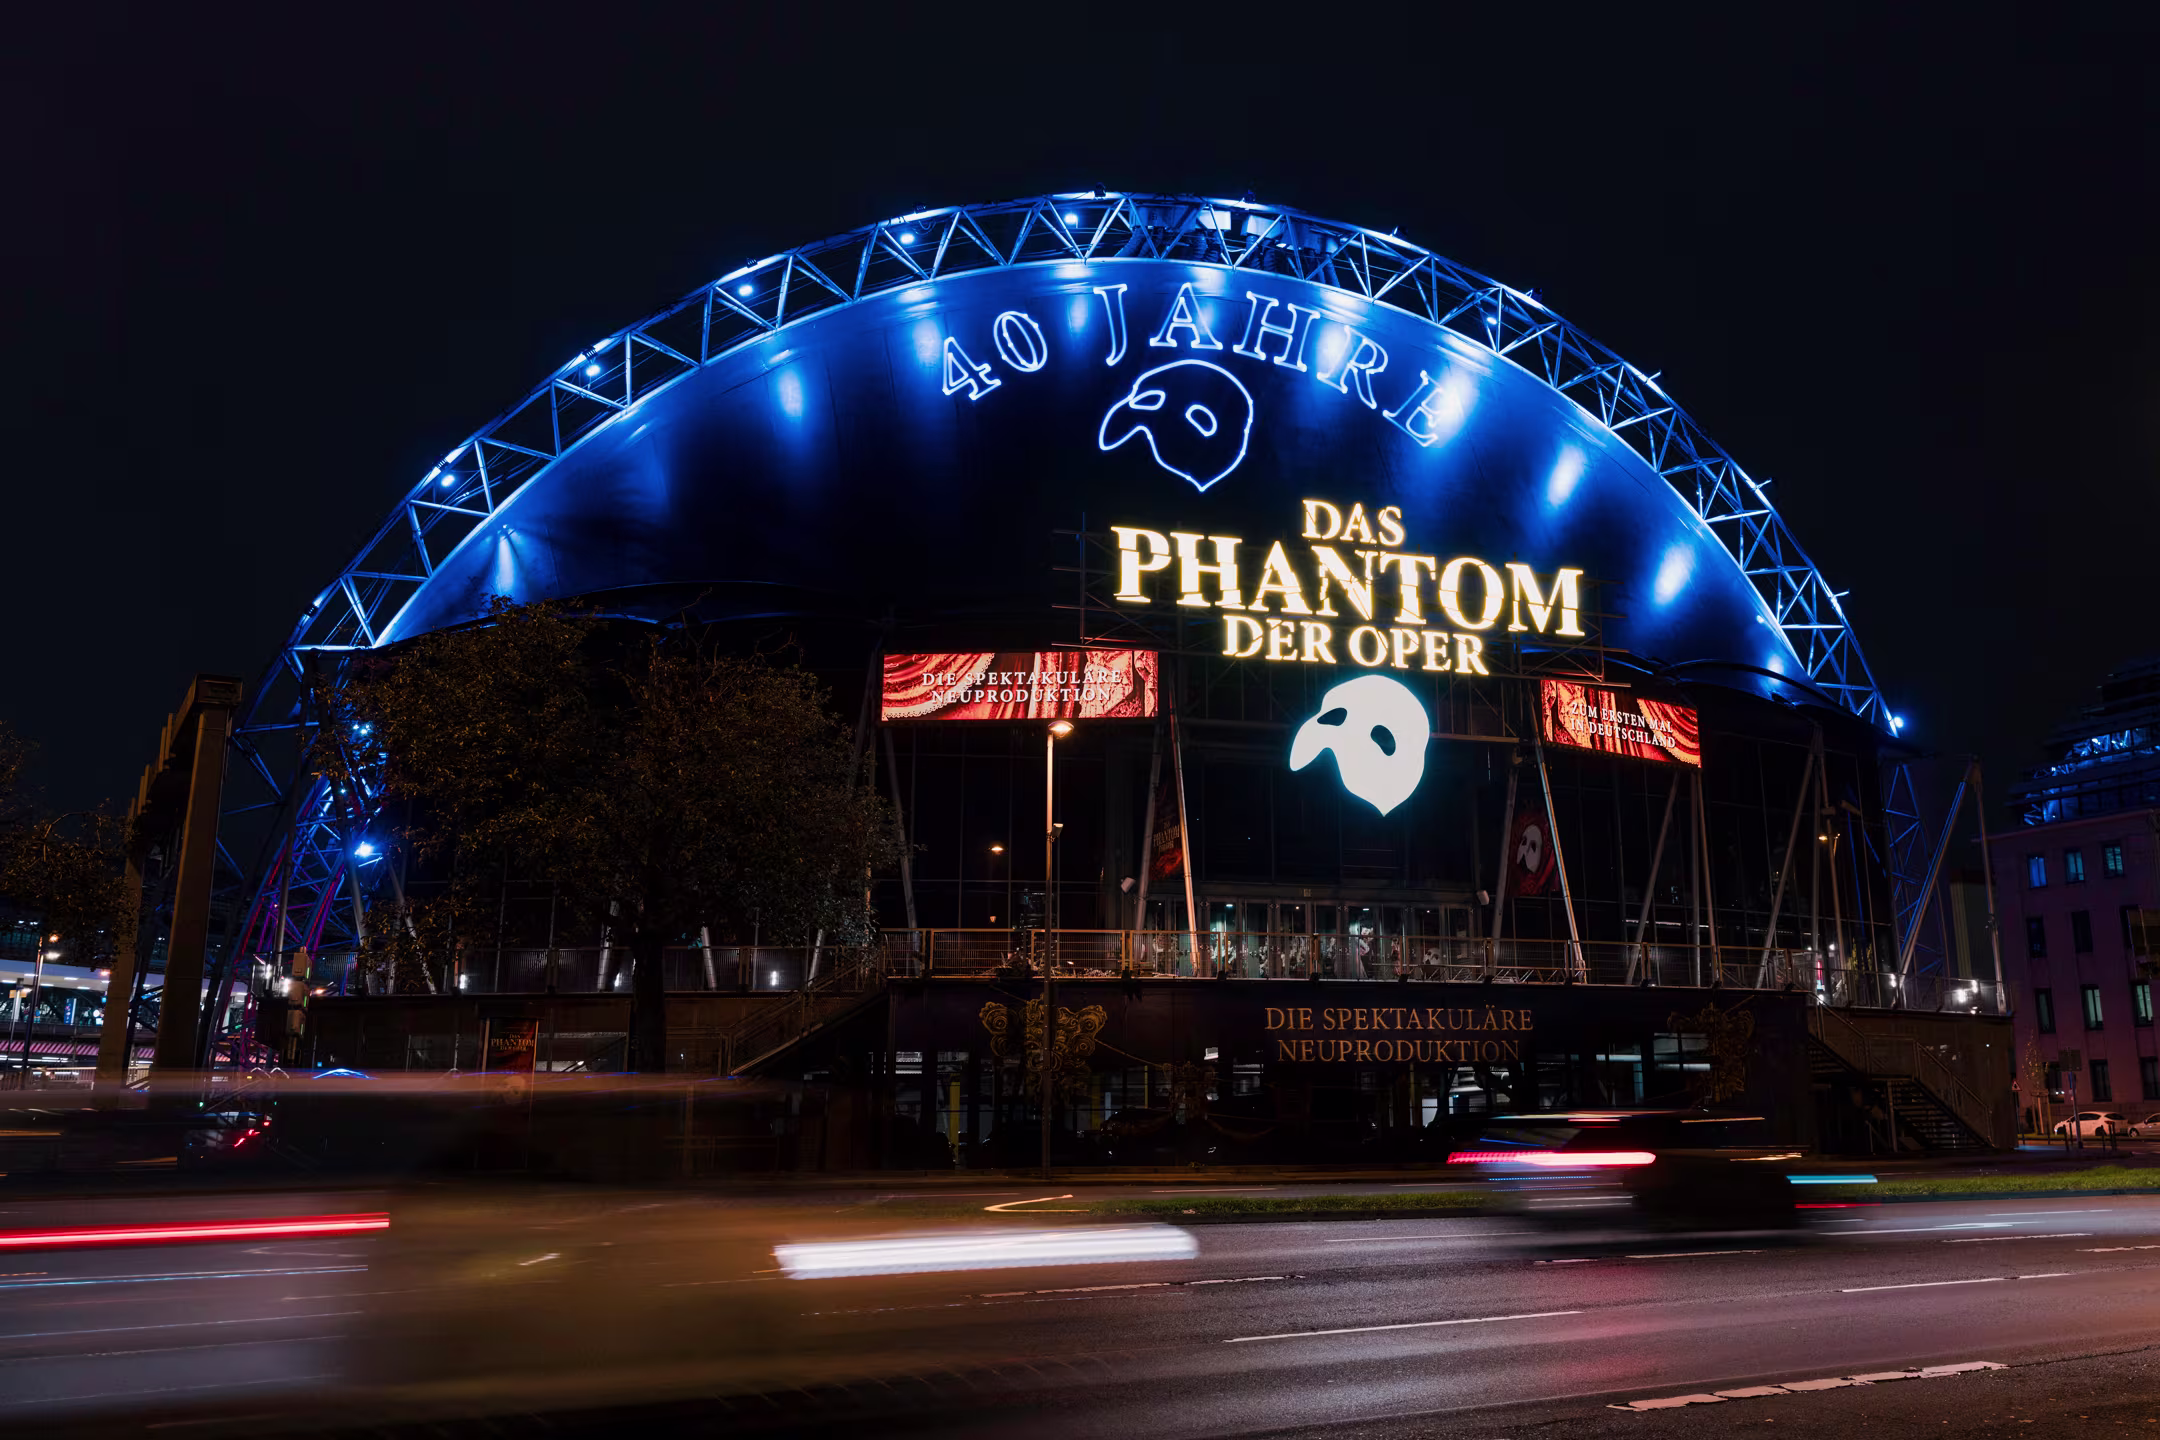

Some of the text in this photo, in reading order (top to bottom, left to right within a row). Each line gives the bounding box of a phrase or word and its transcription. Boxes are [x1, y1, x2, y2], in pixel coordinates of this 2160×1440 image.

[942, 282, 1448, 447] 40 JAHRE
[1302, 499, 1405, 545] DAS
[1111, 525, 1585, 636] PHANTOM
[1222, 614, 1490, 675] DER OPER
[922, 669, 1122, 686] DIE SPEKTAKULÄRE
[931, 688, 1111, 704] NEUPRODUKTION
[1571, 703, 1673, 733] ZUM ERSTEN MAL
[1571, 718, 1676, 748] IN DEUTSCHLAND
[1264, 1004, 1534, 1031] DIE SPEKTAKULÄRE
[1277, 1039, 1519, 1062] NEUPRODUKTION
